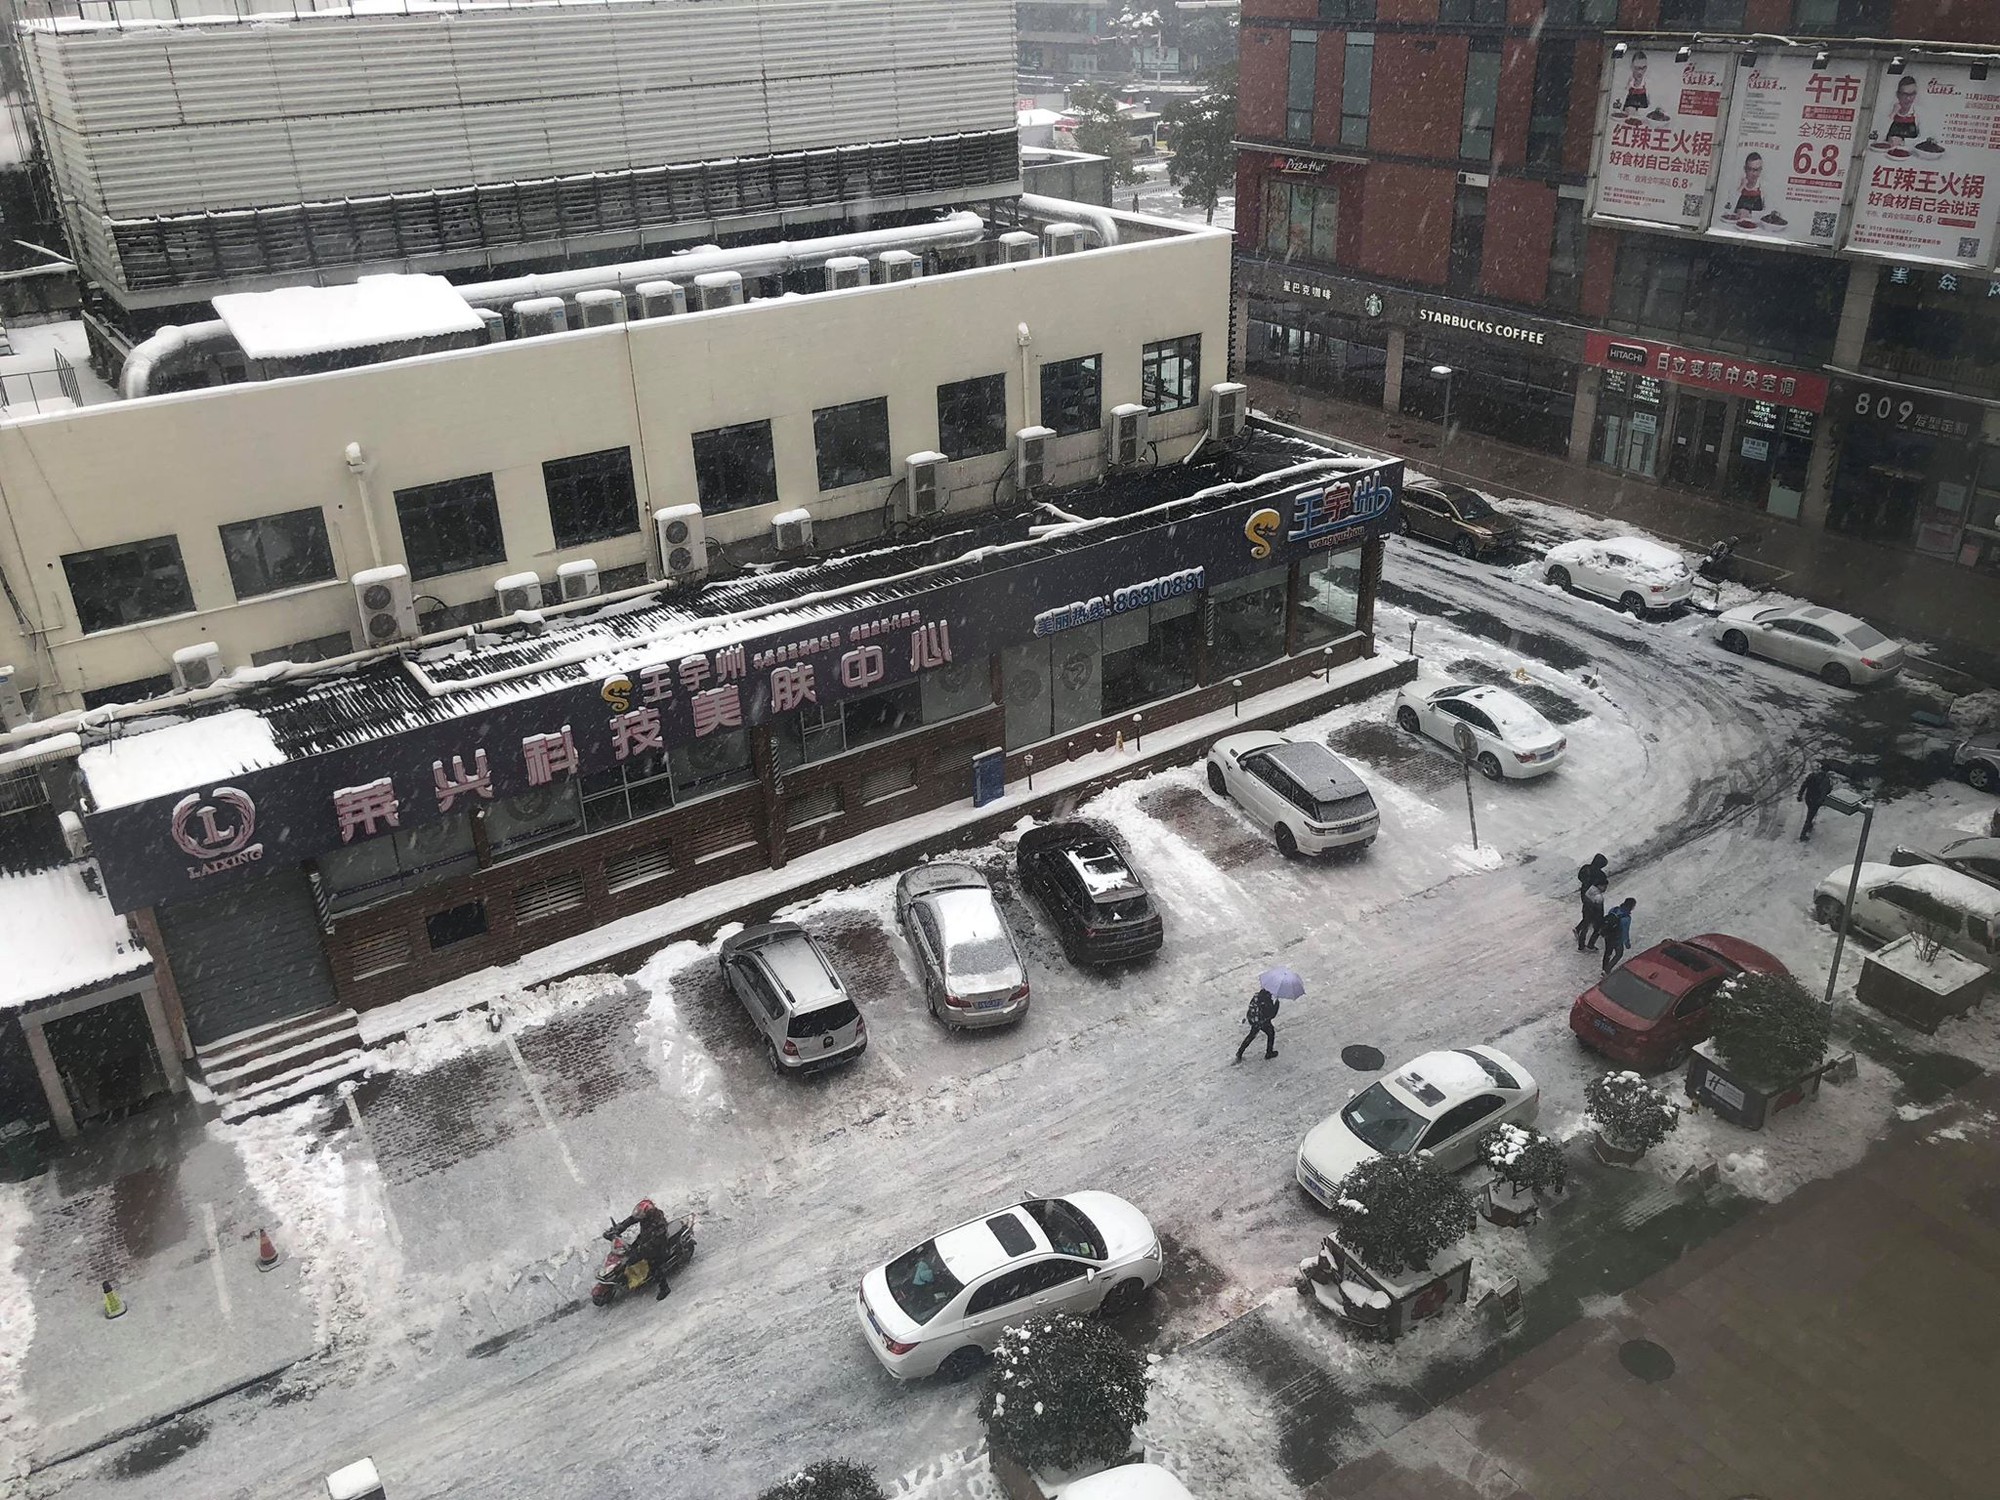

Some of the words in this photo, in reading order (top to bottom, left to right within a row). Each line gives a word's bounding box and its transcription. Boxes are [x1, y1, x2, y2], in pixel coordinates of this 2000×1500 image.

[1805, 73, 1861, 105] 午市
[1611, 123, 1713, 157] 红辣王火锅
[1797, 121, 1852, 141] 全场菜品
[1609, 150, 1710, 176] 好食材自己会说话
[1871, 165, 1985, 199] 红辣王火锅
[1867, 191, 1980, 217] 好食材自己会说话
[1283, 280, 1332, 300] 星巴克咖啡
[1420, 309, 1493, 334] STARBUCKS
[1495, 325, 1545, 345] COFFEE
[1610, 349, 1643, 363] HITACHI
[1657, 353, 1797, 397] 日立变频中央空调
[1855, 392, 1914, 423] 809
[640, 642, 747, 703] 王宇州
[187, 842, 264, 880] LAIXING
